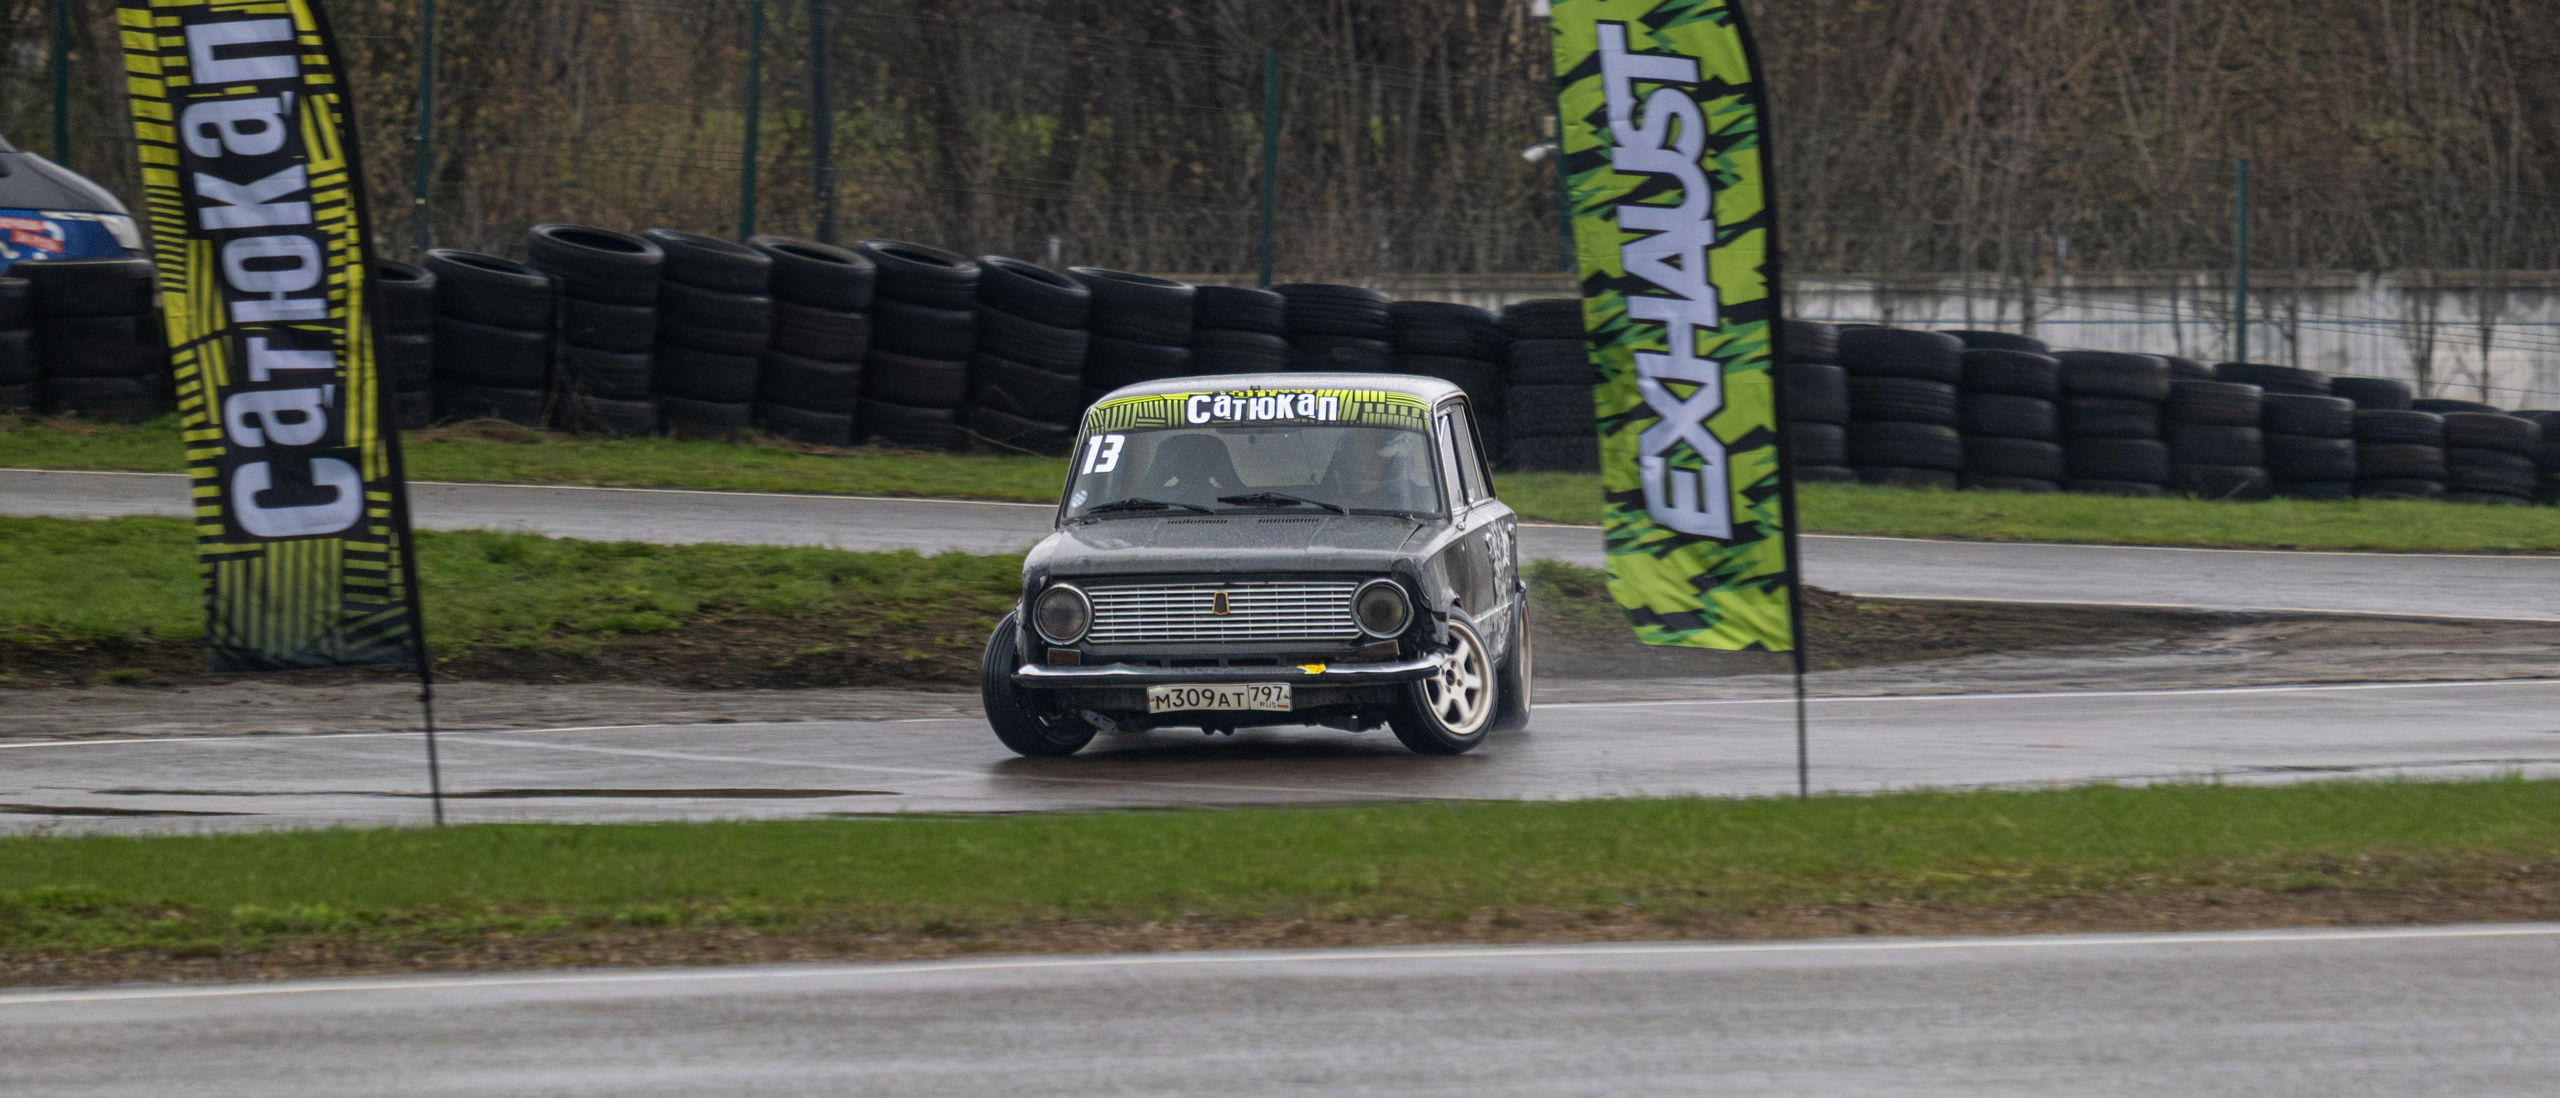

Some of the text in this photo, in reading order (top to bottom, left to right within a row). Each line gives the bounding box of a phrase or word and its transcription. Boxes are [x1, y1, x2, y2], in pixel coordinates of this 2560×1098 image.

[1596, 20, 1734, 541] EXHAUST
[1082, 434, 1126, 475] 13
[1250, 686, 1283, 702] 797
[1259, 701, 1277, 709] RUS
